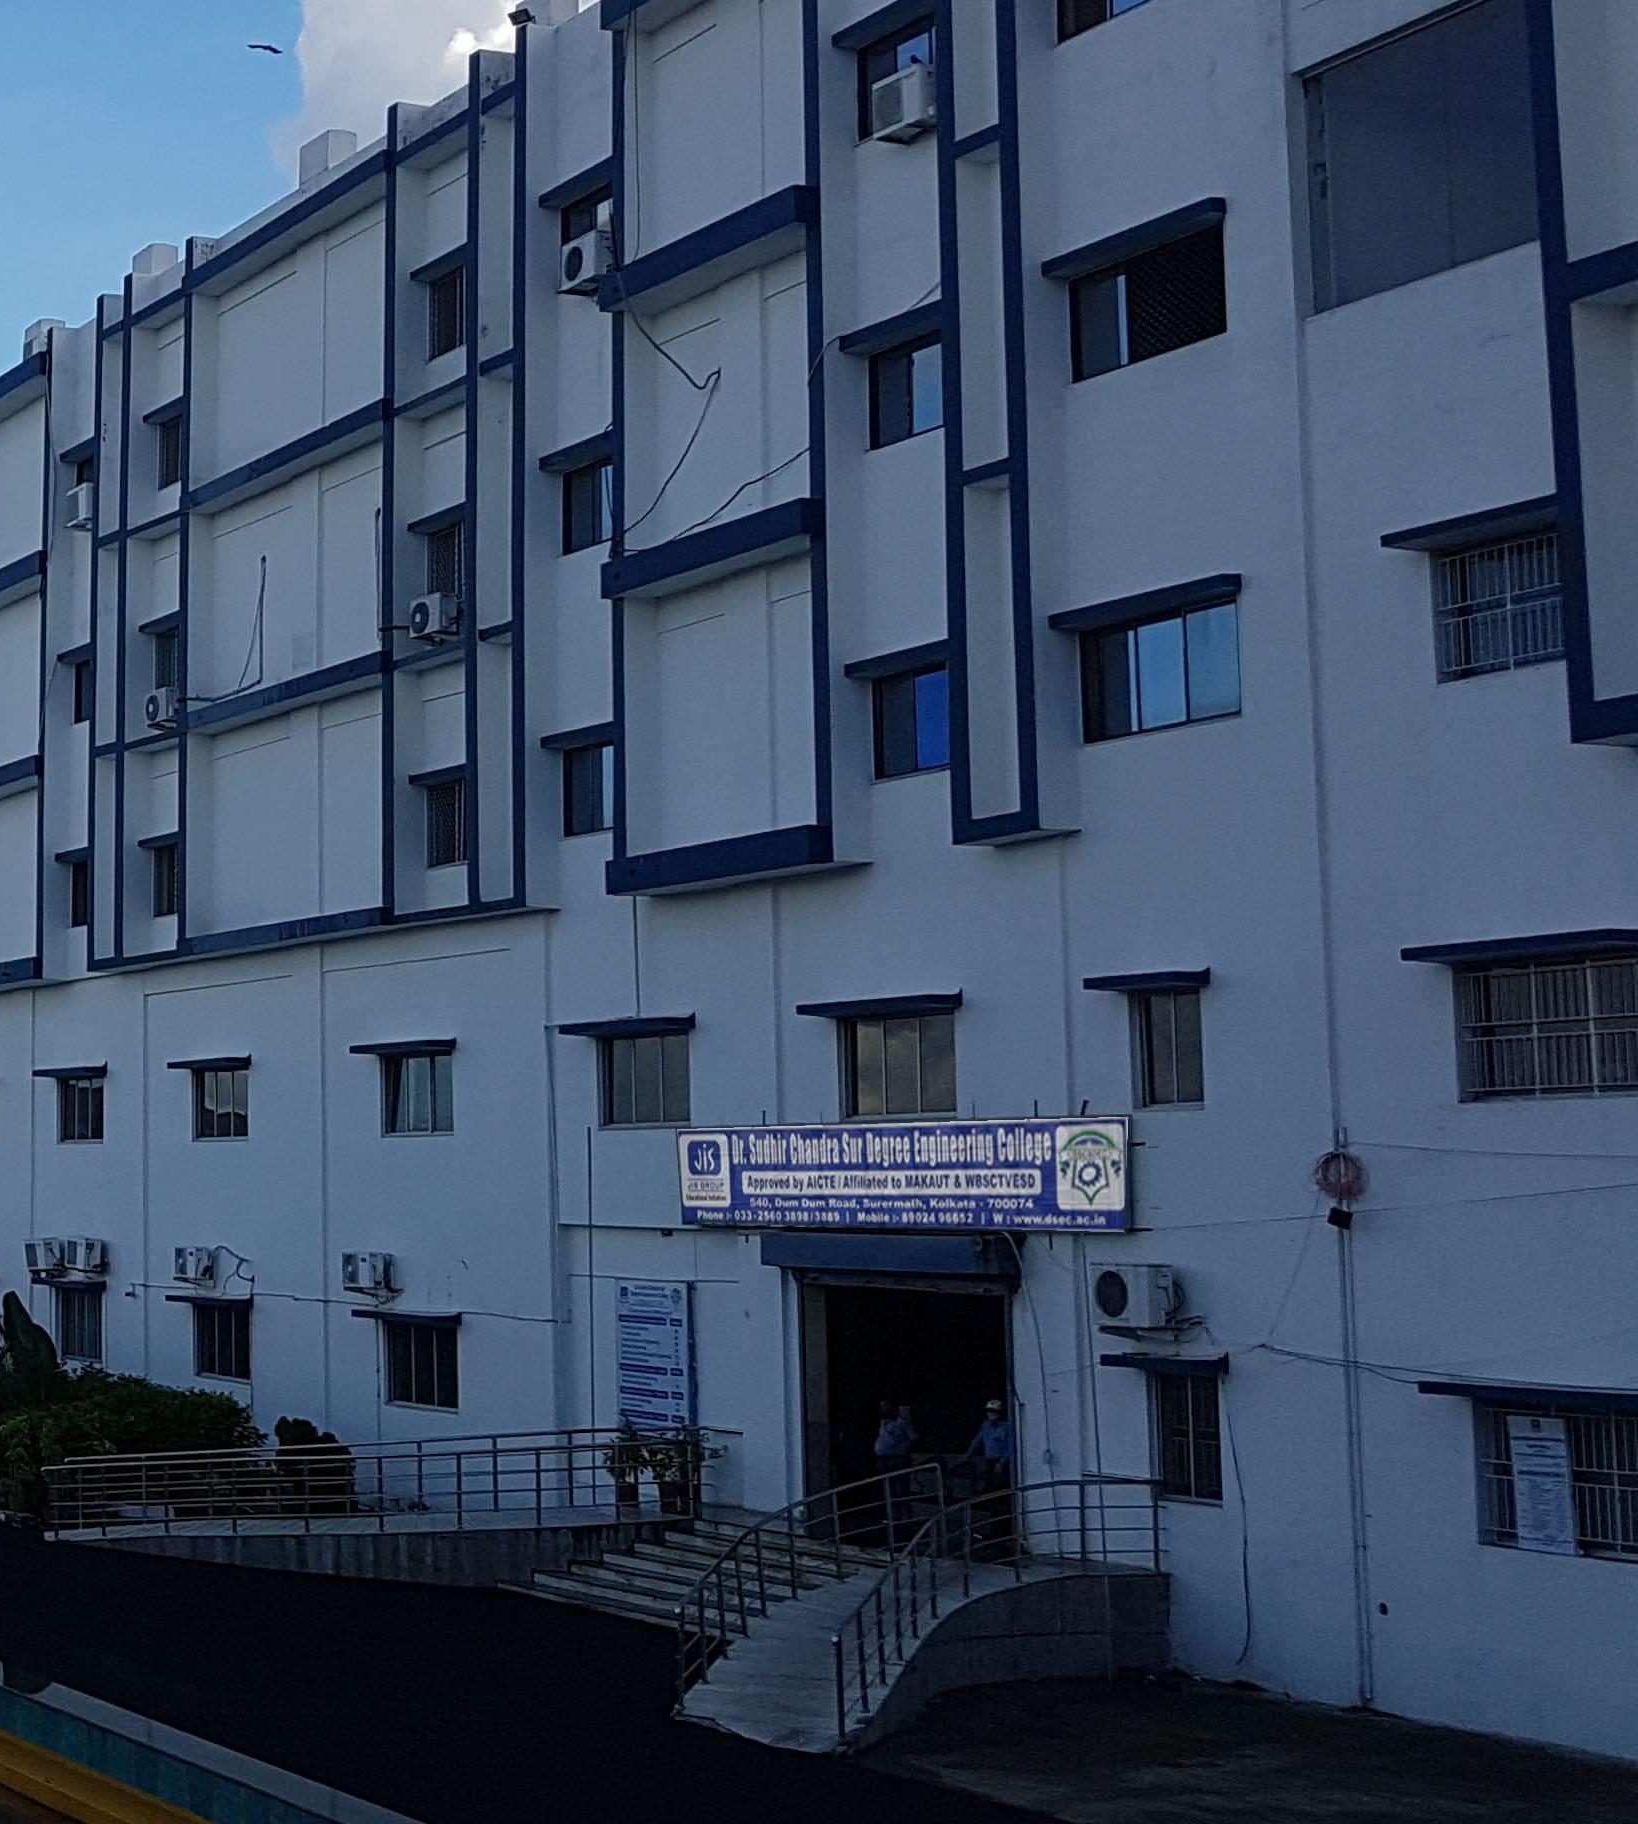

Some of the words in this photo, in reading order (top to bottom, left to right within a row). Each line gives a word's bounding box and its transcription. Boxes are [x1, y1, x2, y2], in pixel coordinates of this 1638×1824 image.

[732, 1134, 747, 1165] Dr.
[748, 1133, 787, 1165] Sudhir
[789, 1132, 840, 1165] Chandra
[842, 1131, 863, 1164] Sur
[866, 1131, 911, 1168] Degree
[913, 1128, 994, 1167] Engineering
[997, 1127, 1052, 1166] College
[747, 1175, 791, 1192] Approved
[792, 1175, 804, 1192] by
[806, 1174, 837, 1190] AICTE
[843, 1174, 888, 1190] Affiliated
[891, 1175, 902, 1189] to
[905, 1174, 951, 1189] MAKAUT
[954, 1173, 962, 1189] &
[965, 1173, 1036, 1189] WBSCTVESD
[775, 1198, 799, 1208] Dum
[801, 1198, 826, 1208] Dum
[829, 1197, 860, 1209] Road,
[863, 1198, 927, 1210] Surermath,
[929, 1198, 976, 1209] Kolkata
[987, 1198, 1034, 1209] 700074
[696, 1210, 724, 1220] Phone
[857, 1211, 890, 1222] Mobile
[992, 1213, 1003, 1224] W
[1013, 1213, 1106, 1225] www.dsec.ac.in
